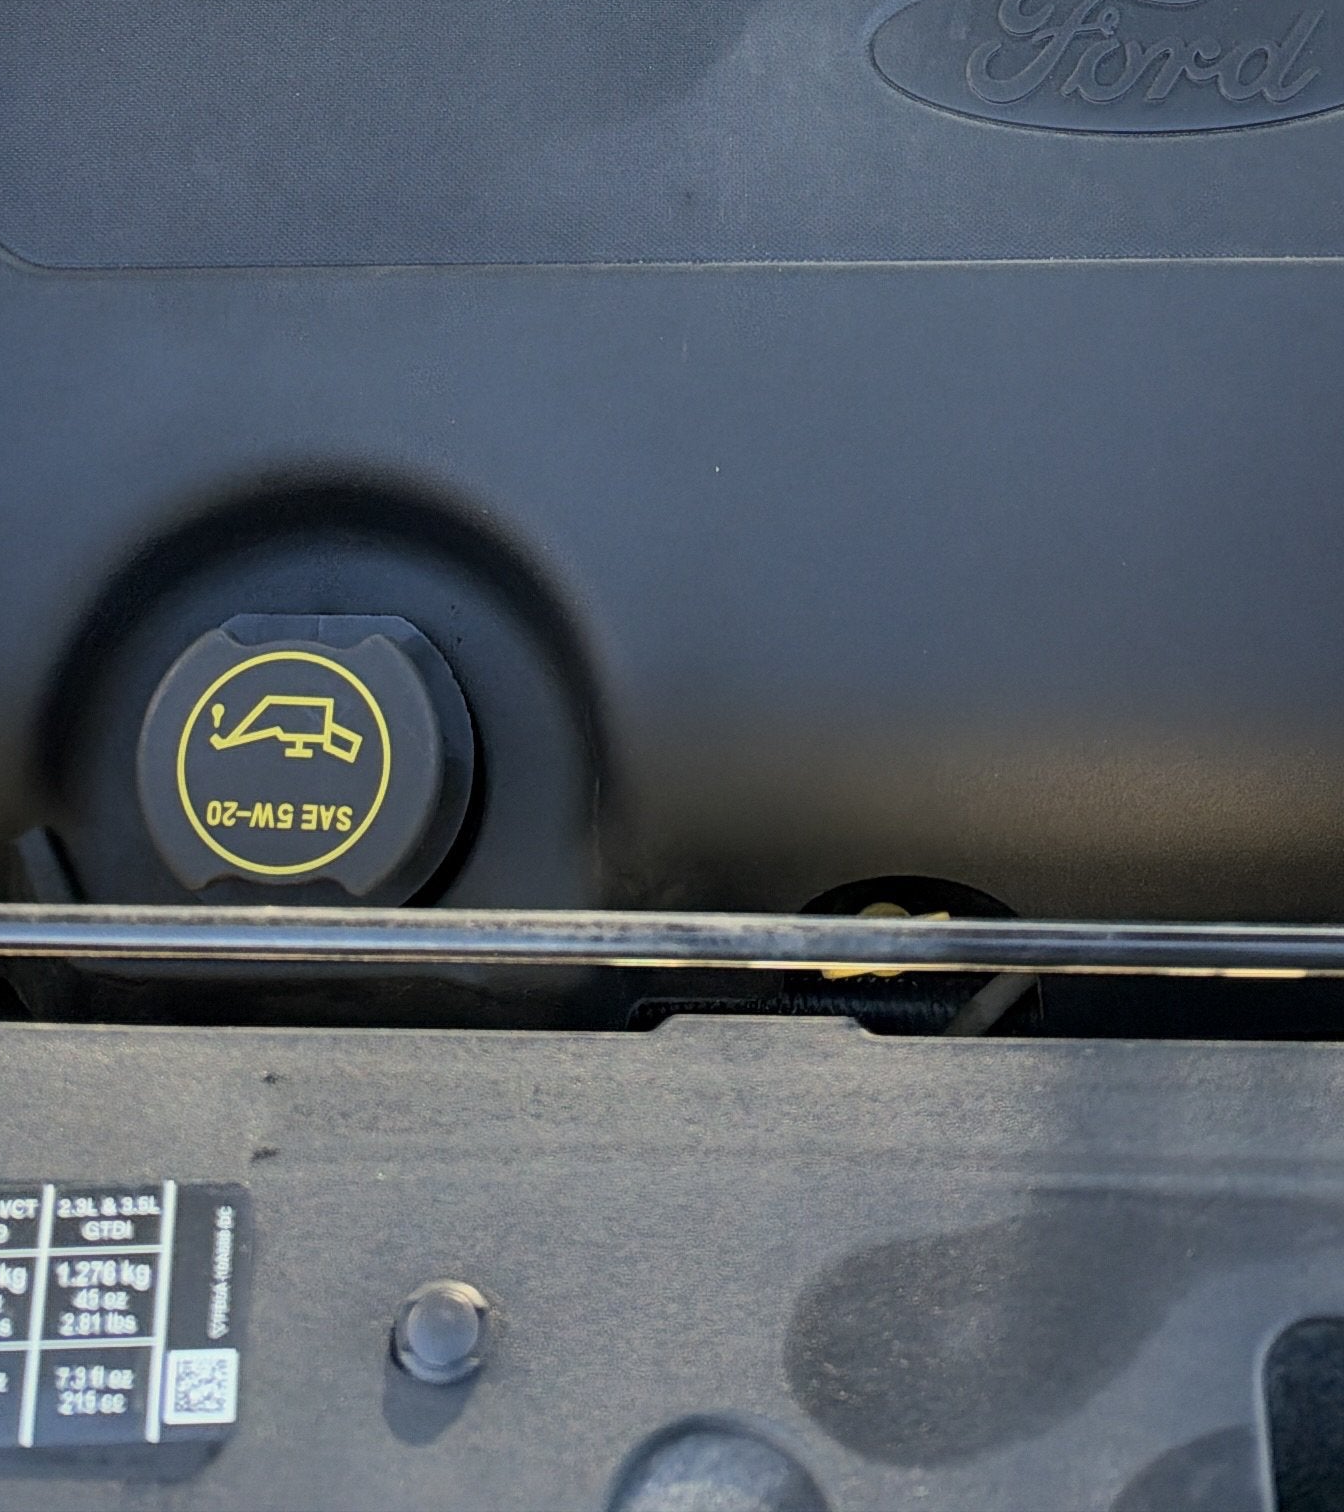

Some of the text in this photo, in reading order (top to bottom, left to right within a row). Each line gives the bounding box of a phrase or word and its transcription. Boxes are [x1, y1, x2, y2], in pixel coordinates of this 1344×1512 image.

[206, 799, 353, 832] SAE 5W-20
[100, 1196, 117, 1217] &
[119, 1259, 152, 1291] kg
[102, 1290, 130, 1311] oz
[105, 1311, 139, 1335] lbs
[107, 1368, 136, 1390] oz
